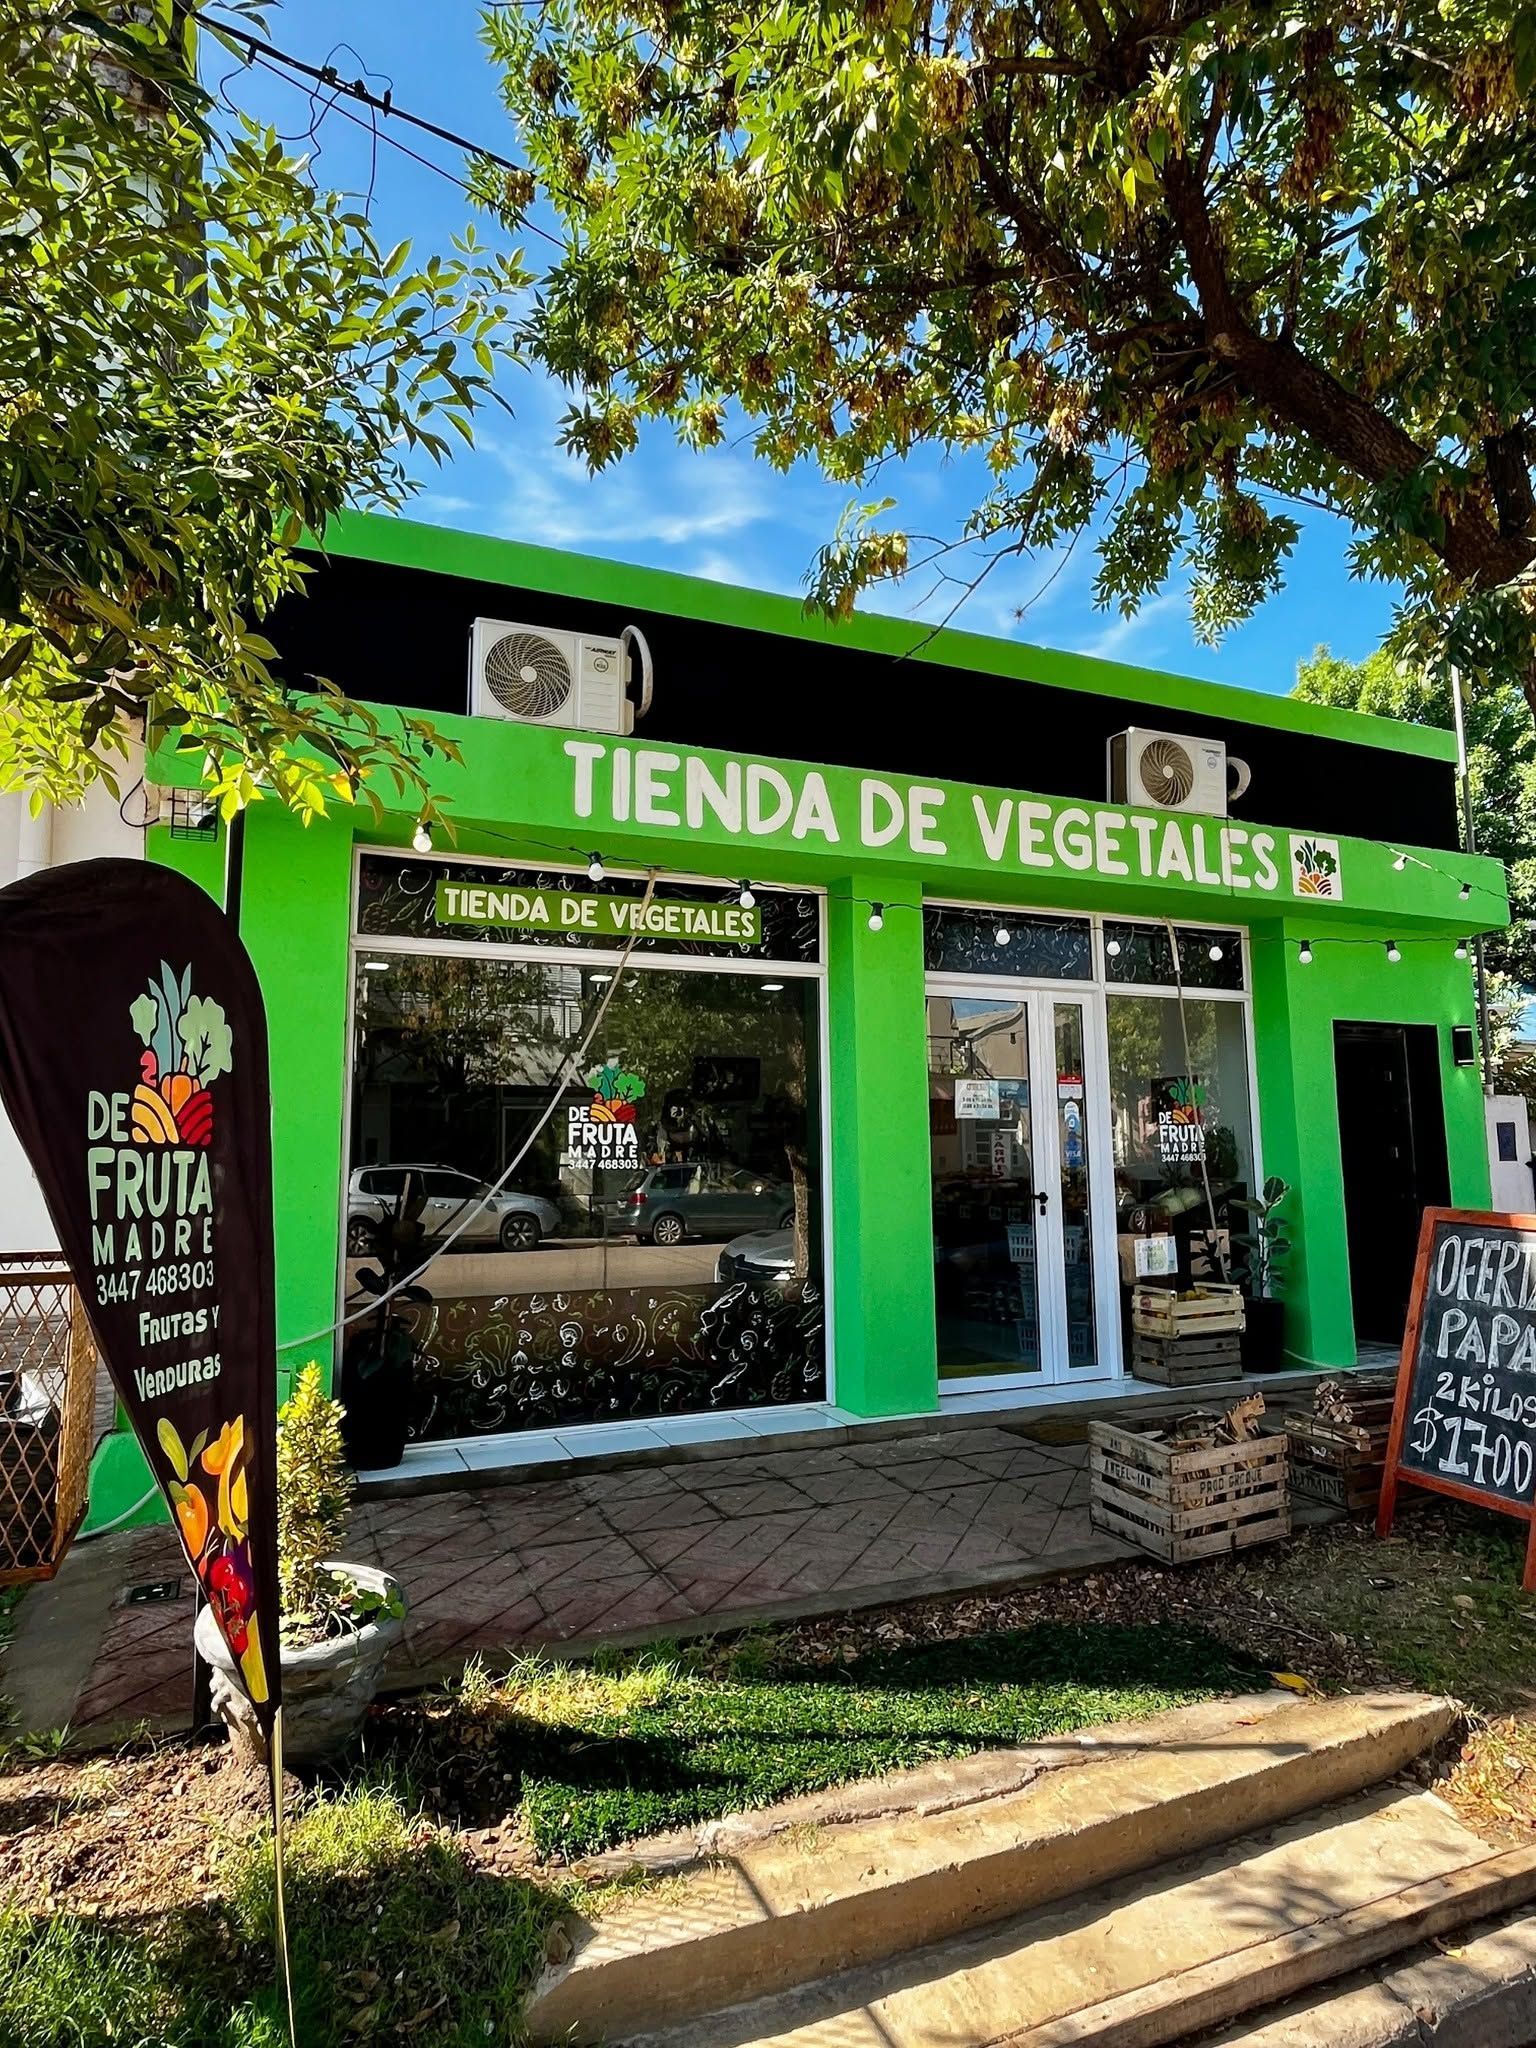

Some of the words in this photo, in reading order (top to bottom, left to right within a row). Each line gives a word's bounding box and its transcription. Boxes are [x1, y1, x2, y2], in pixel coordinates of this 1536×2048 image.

[563, 740, 840, 843] TIENDA
[860, 778, 948, 855] DE
[972, 794, 1280, 890] VEGETALES
[443, 888, 549, 923] TIENDA
[561, 898, 598, 927] DE
[609, 901, 755, 938] VEGETALES
[87, 1090, 130, 1142] DE
[568, 1106, 590, 1122] DE
[1158, 1111, 1173, 1124] DE
[568, 1123, 638, 1145] FRUTA
[1160, 1124, 1205, 1142] FRUTA
[568, 1145, 638, 1158] MADRE
[1160, 1142, 1206, 1154] MADRE
[1161, 1153, 1179, 1162] 3447
[568, 1159, 596, 1169] 3447
[597, 1159, 638, 1169] 468303
[87, 1147, 213, 1220] FRUTA
[92, 1216, 213, 1266] MADRE
[96, 1270, 141, 1305] 3447
[145, 1260, 214, 1296] 468303
[1436, 1371, 1456, 1401] 2
[1410, 1396, 1534, 1494] $1700
